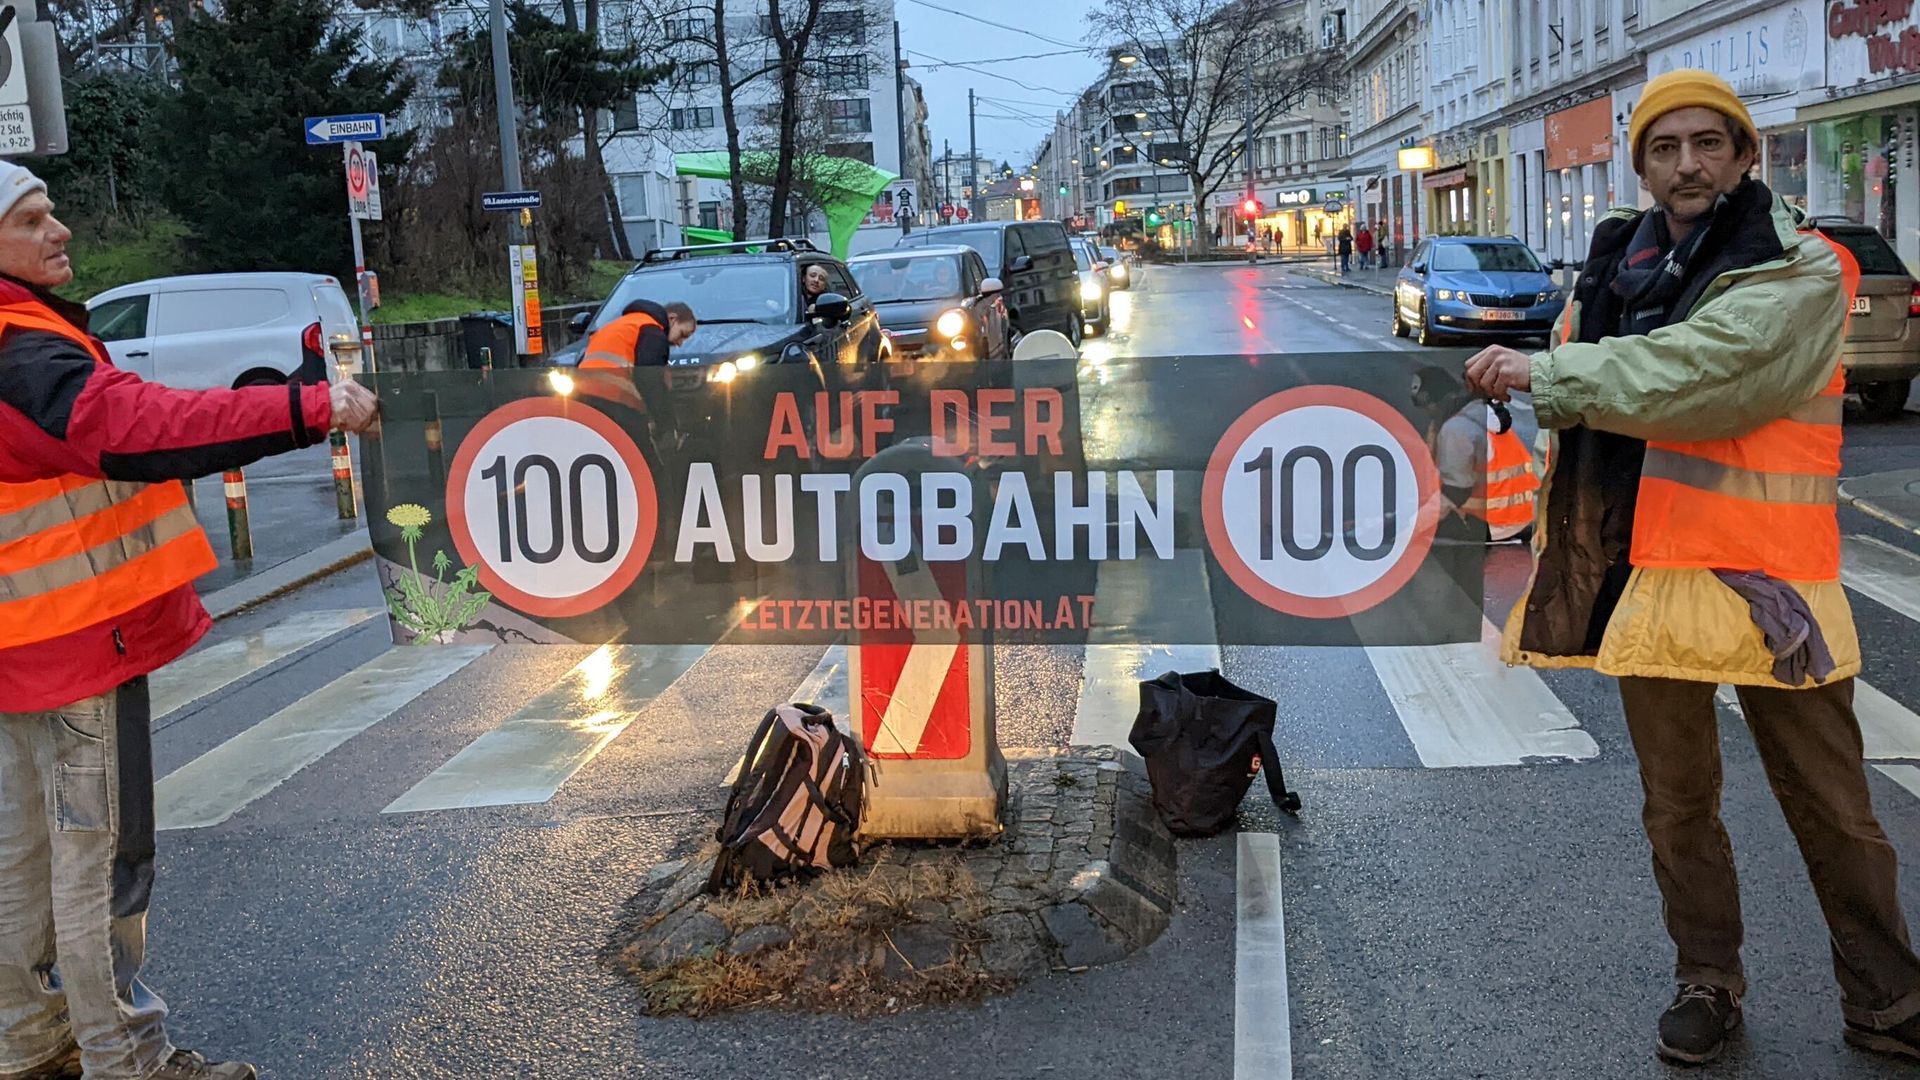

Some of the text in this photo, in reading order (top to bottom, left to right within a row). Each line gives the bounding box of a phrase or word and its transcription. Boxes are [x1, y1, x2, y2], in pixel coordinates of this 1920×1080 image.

[1684, 26, 1769, 74] PAULIS
[1, 125, 5, 135] 2
[330, 122, 372, 134] EINBAHN
[352, 160, 361, 181] 30
[353, 196, 367, 213] Zone
[764, 388, 1064, 460] AUF DER
[481, 453, 620, 565] 100
[674, 461, 1175, 563] AUTOBAHN
[1243, 443, 1397, 563] 100
